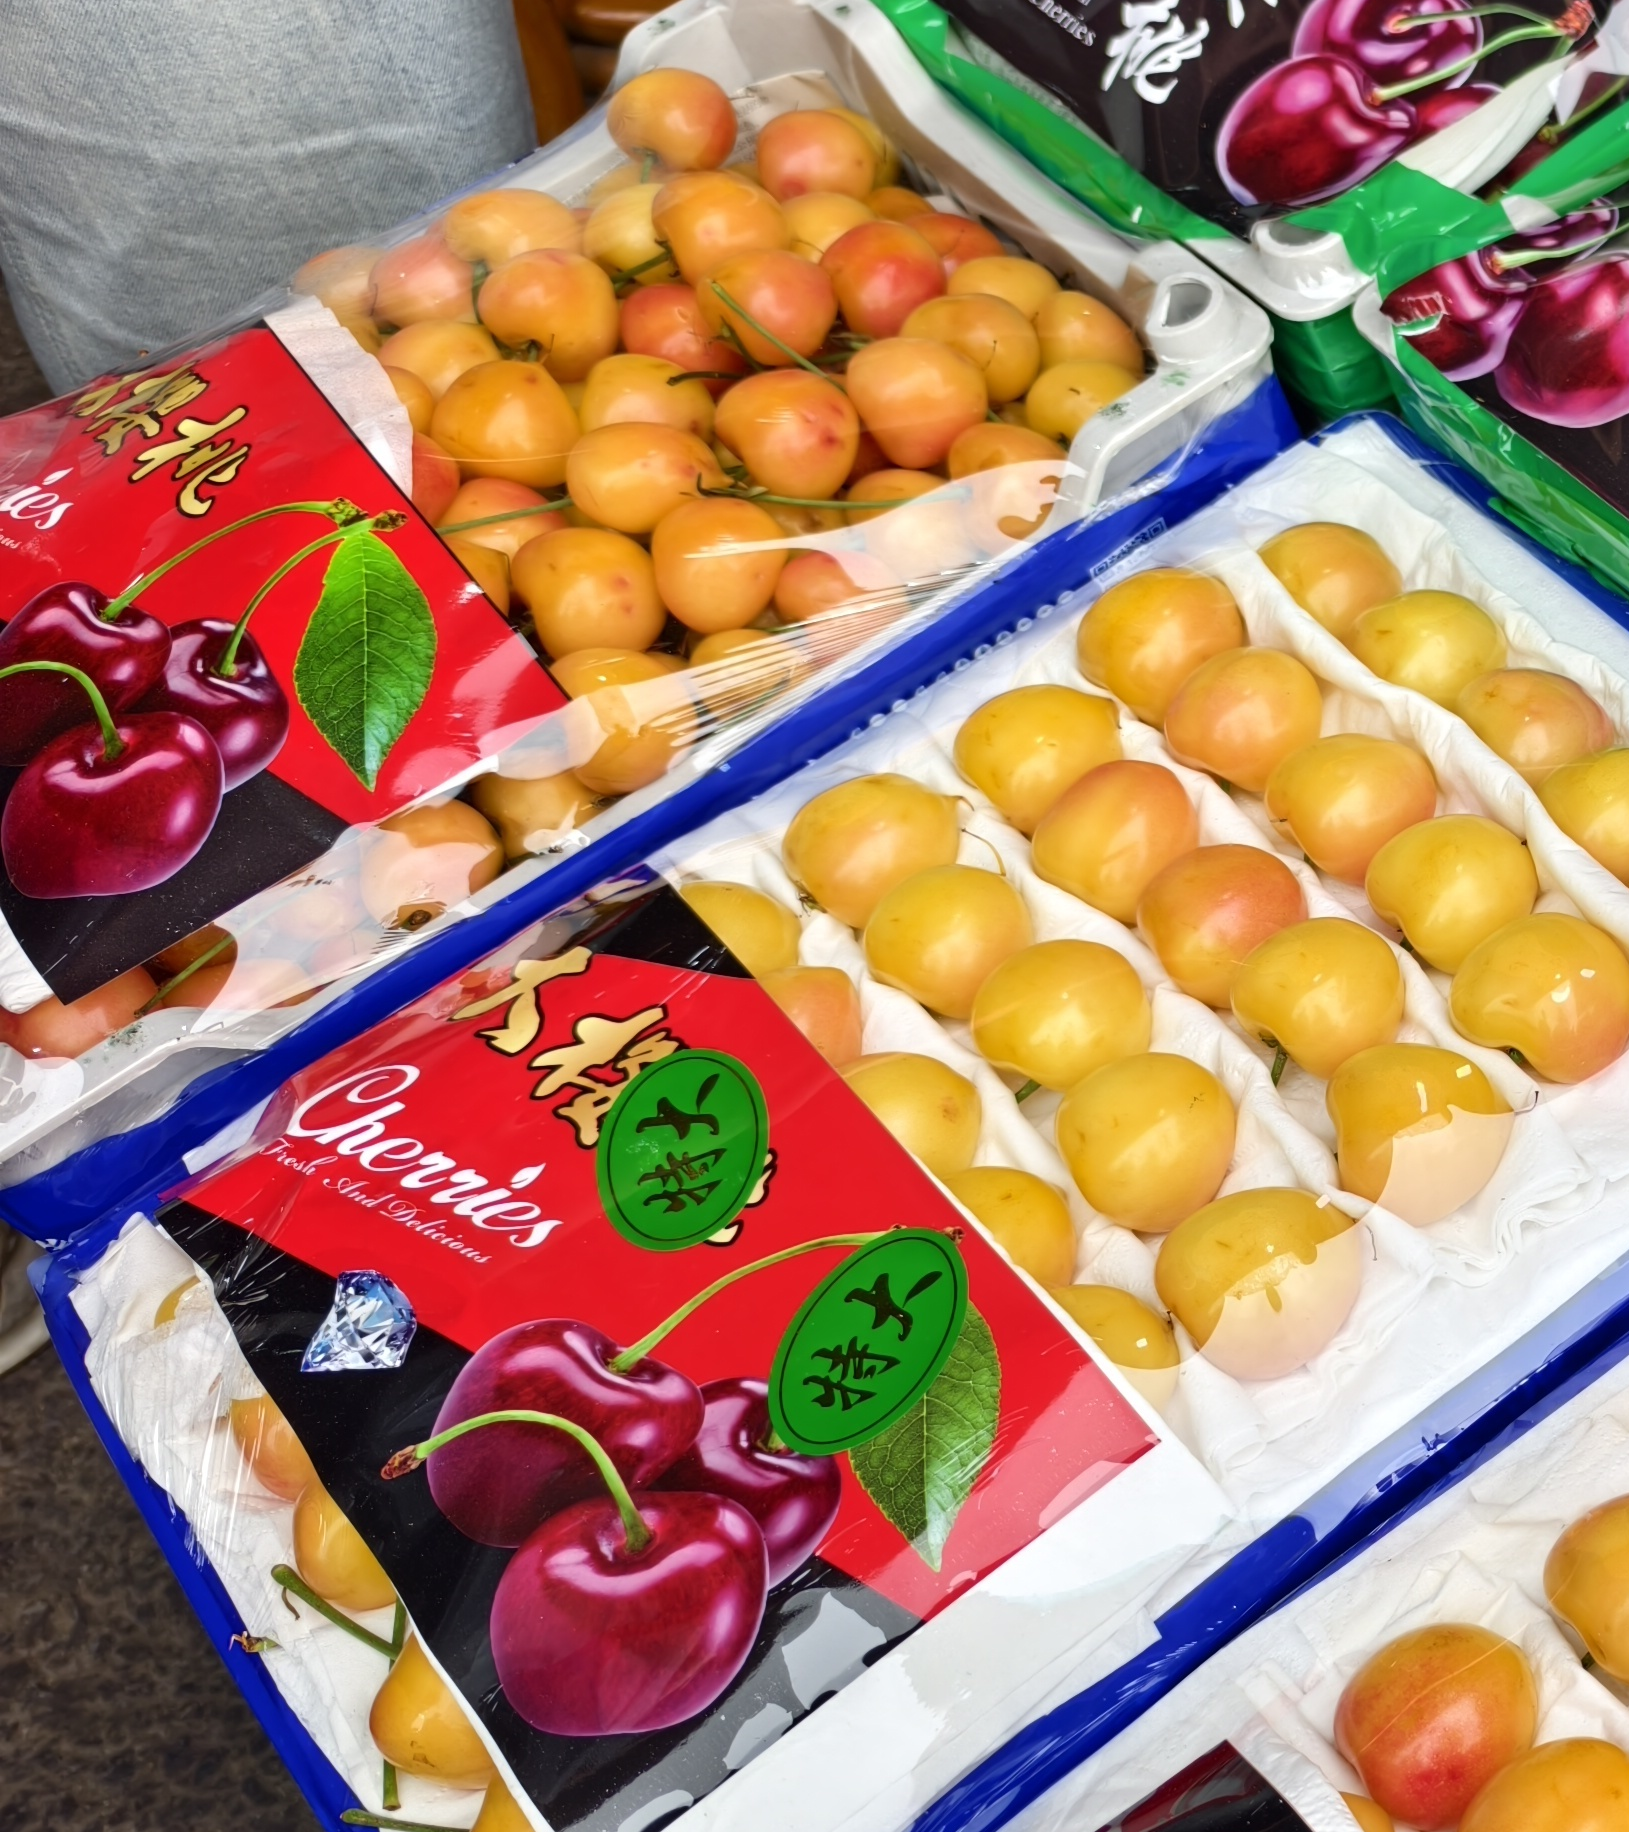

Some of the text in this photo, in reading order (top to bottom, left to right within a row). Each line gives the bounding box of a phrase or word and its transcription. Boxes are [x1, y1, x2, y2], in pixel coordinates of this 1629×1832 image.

[1028, 0, 1096, 47] herries
[1101, 0, 1277, 104] 桃
[259, 1137, 493, 1264] Fresh And Delicious
[286, 1064, 564, 1248] Cherries
[635, 1073, 728, 1214] 特大
[803, 1270, 943, 1412] 特大
